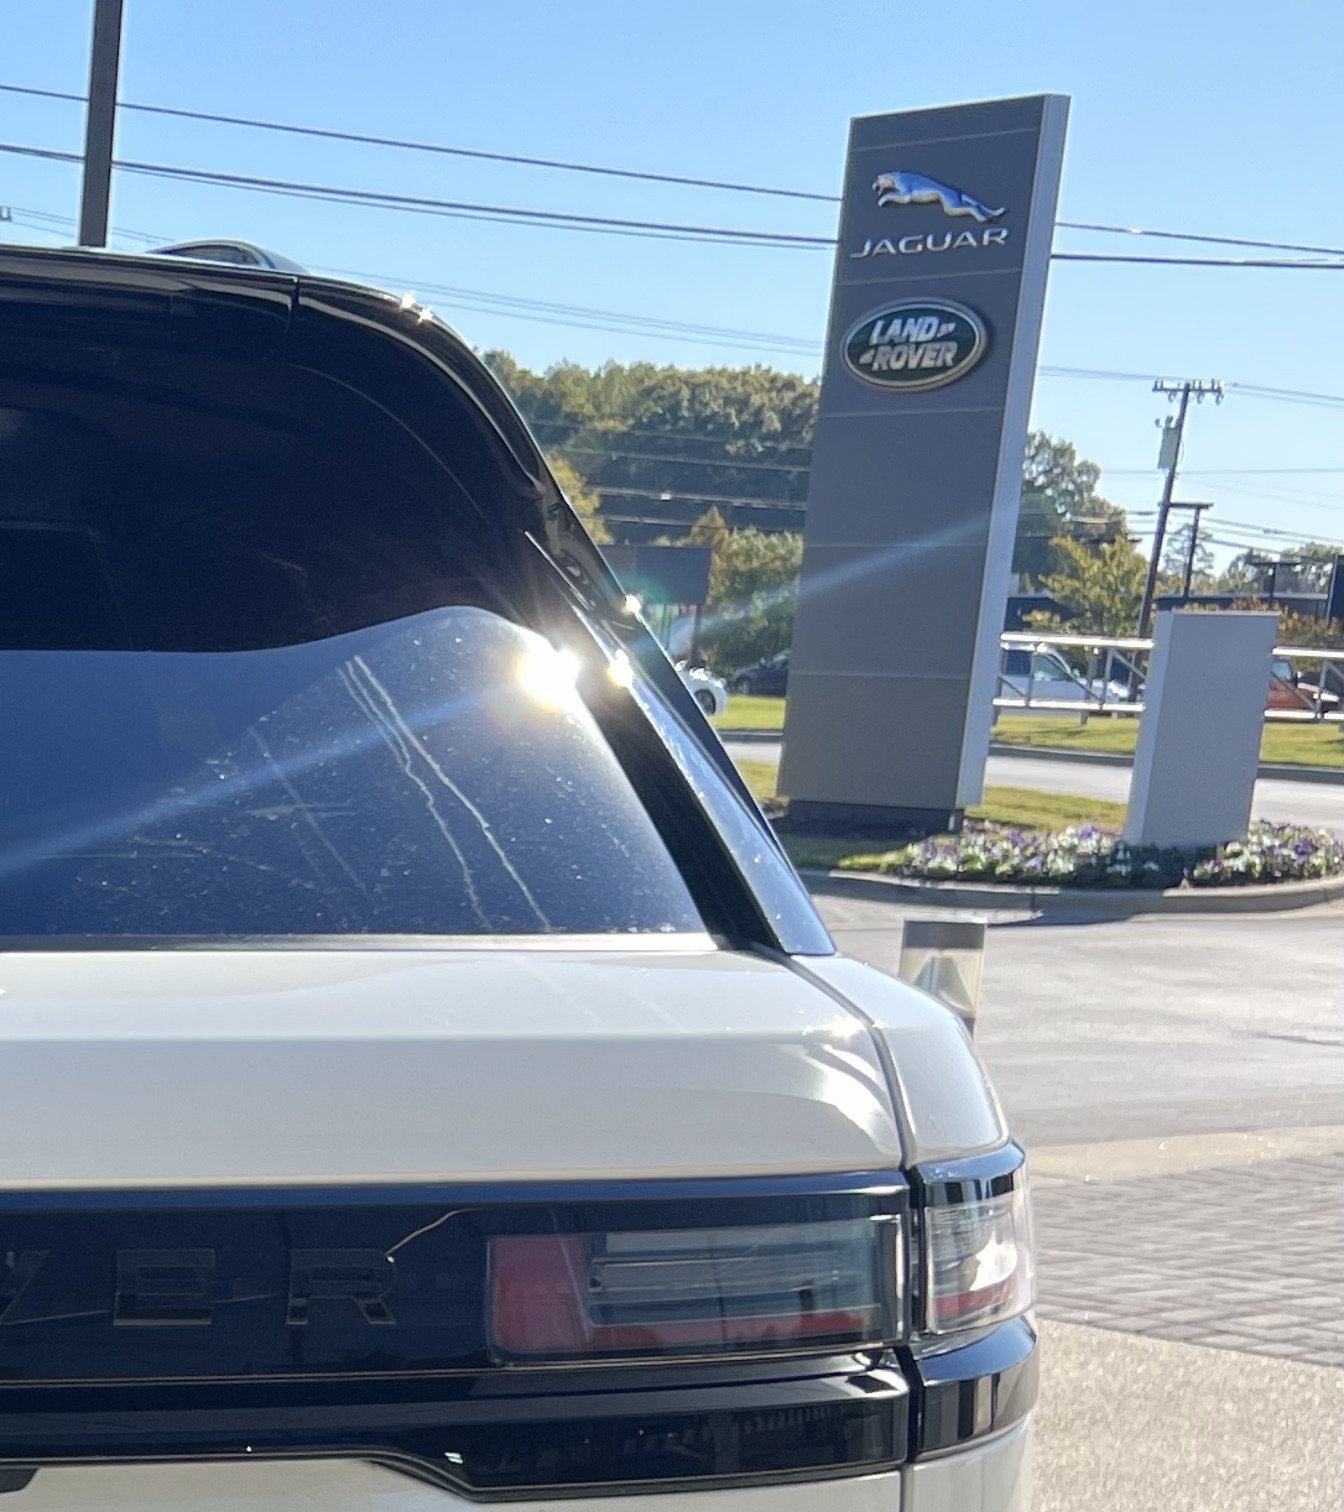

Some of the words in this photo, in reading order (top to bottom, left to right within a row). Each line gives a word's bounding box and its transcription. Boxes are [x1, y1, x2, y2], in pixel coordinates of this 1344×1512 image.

[850, 227, 1009, 259] JAGUAR
[869, 315, 939, 347] LAND
[872, 340, 959, 372] ROVER
